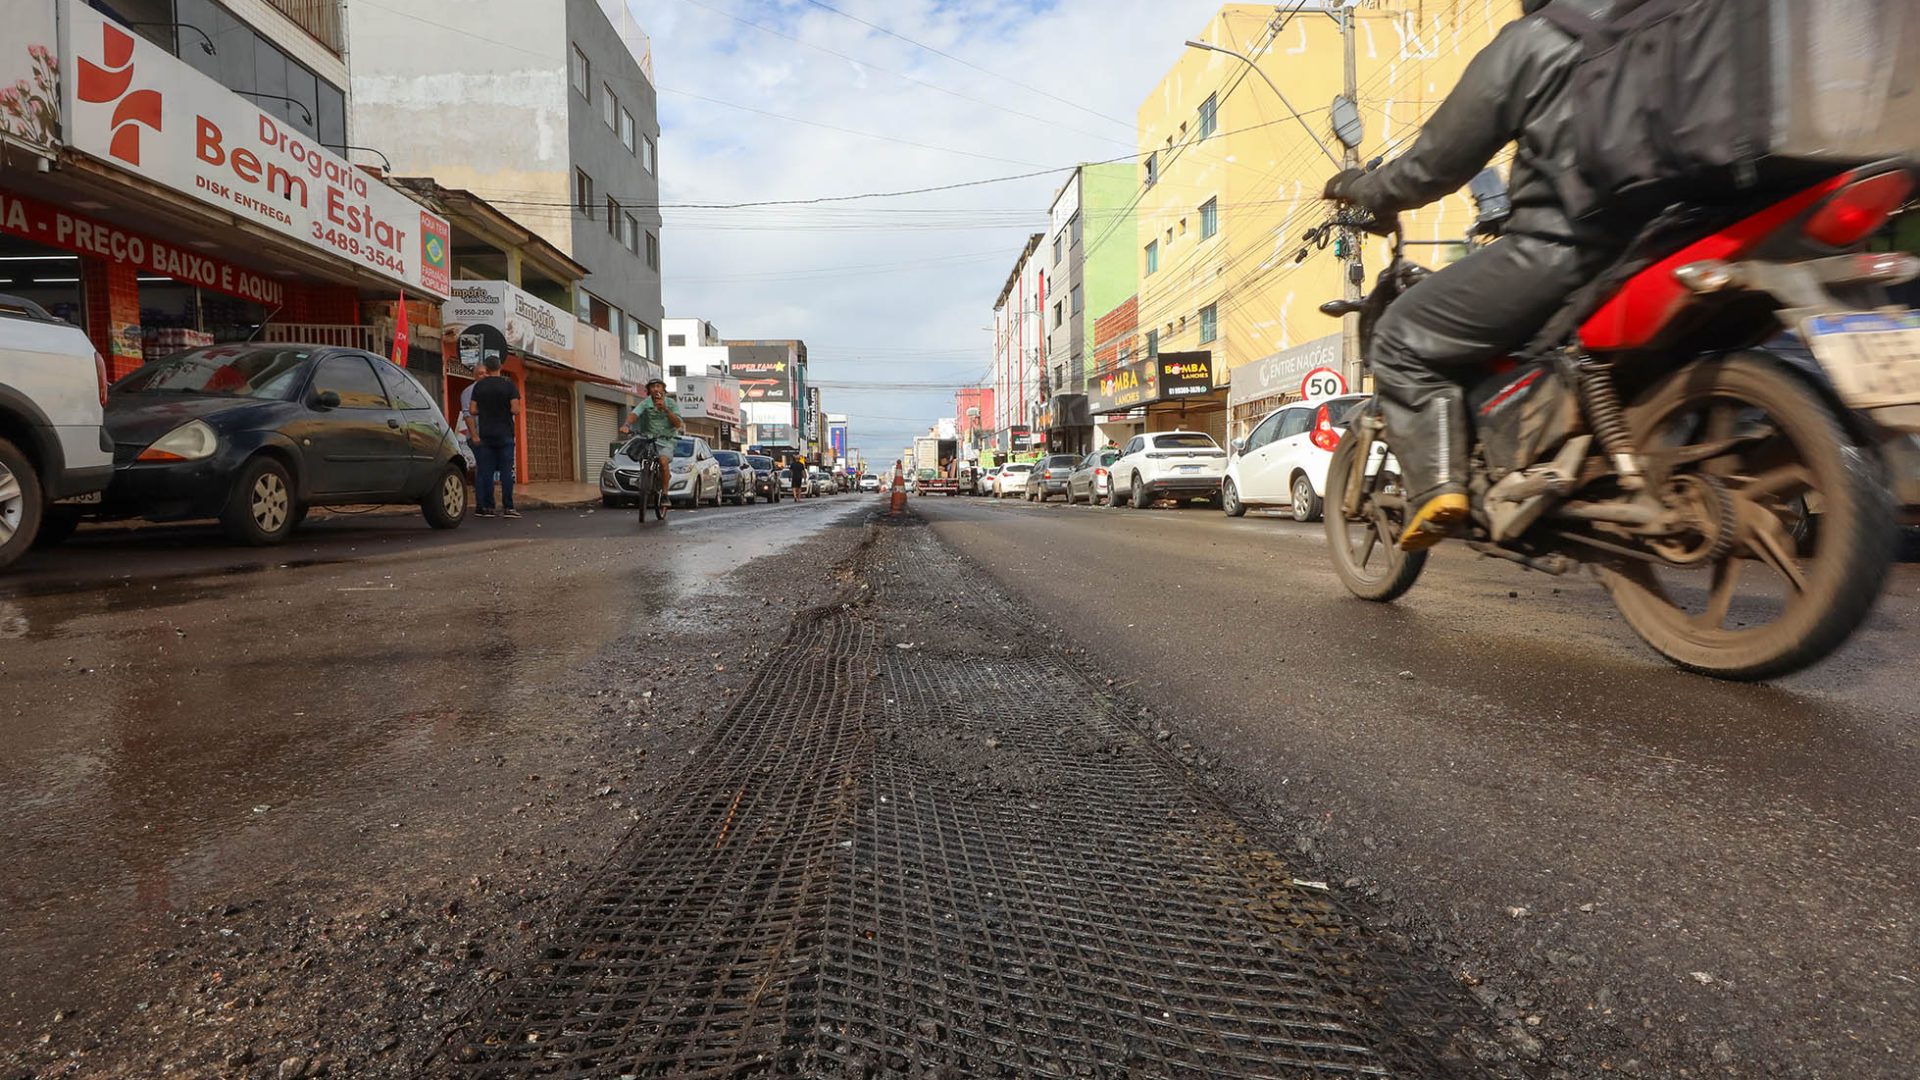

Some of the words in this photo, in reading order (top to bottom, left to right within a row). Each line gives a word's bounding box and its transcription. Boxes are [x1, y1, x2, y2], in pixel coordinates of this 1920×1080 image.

[259, 114, 367, 199] Drogaria
[196, 114, 308, 209] Bem
[327, 185, 405, 254] Estar
[196, 175, 230, 200] DISK
[234, 191, 292, 226] ENTREGA
[57, 213, 145, 264] PREÇO
[152, 243, 216, 286] BAIXO
[221, 266, 233, 291] É
[312, 221, 404, 275] 3489-3544
[515, 293, 557, 331] Empório
[1270, 356, 1296, 379] ENTRE
[1297, 345, 1335, 371] NAÇÕES
[1310, 378, 1337, 396] 50
[1115, 391, 1140, 406] LANCHES
